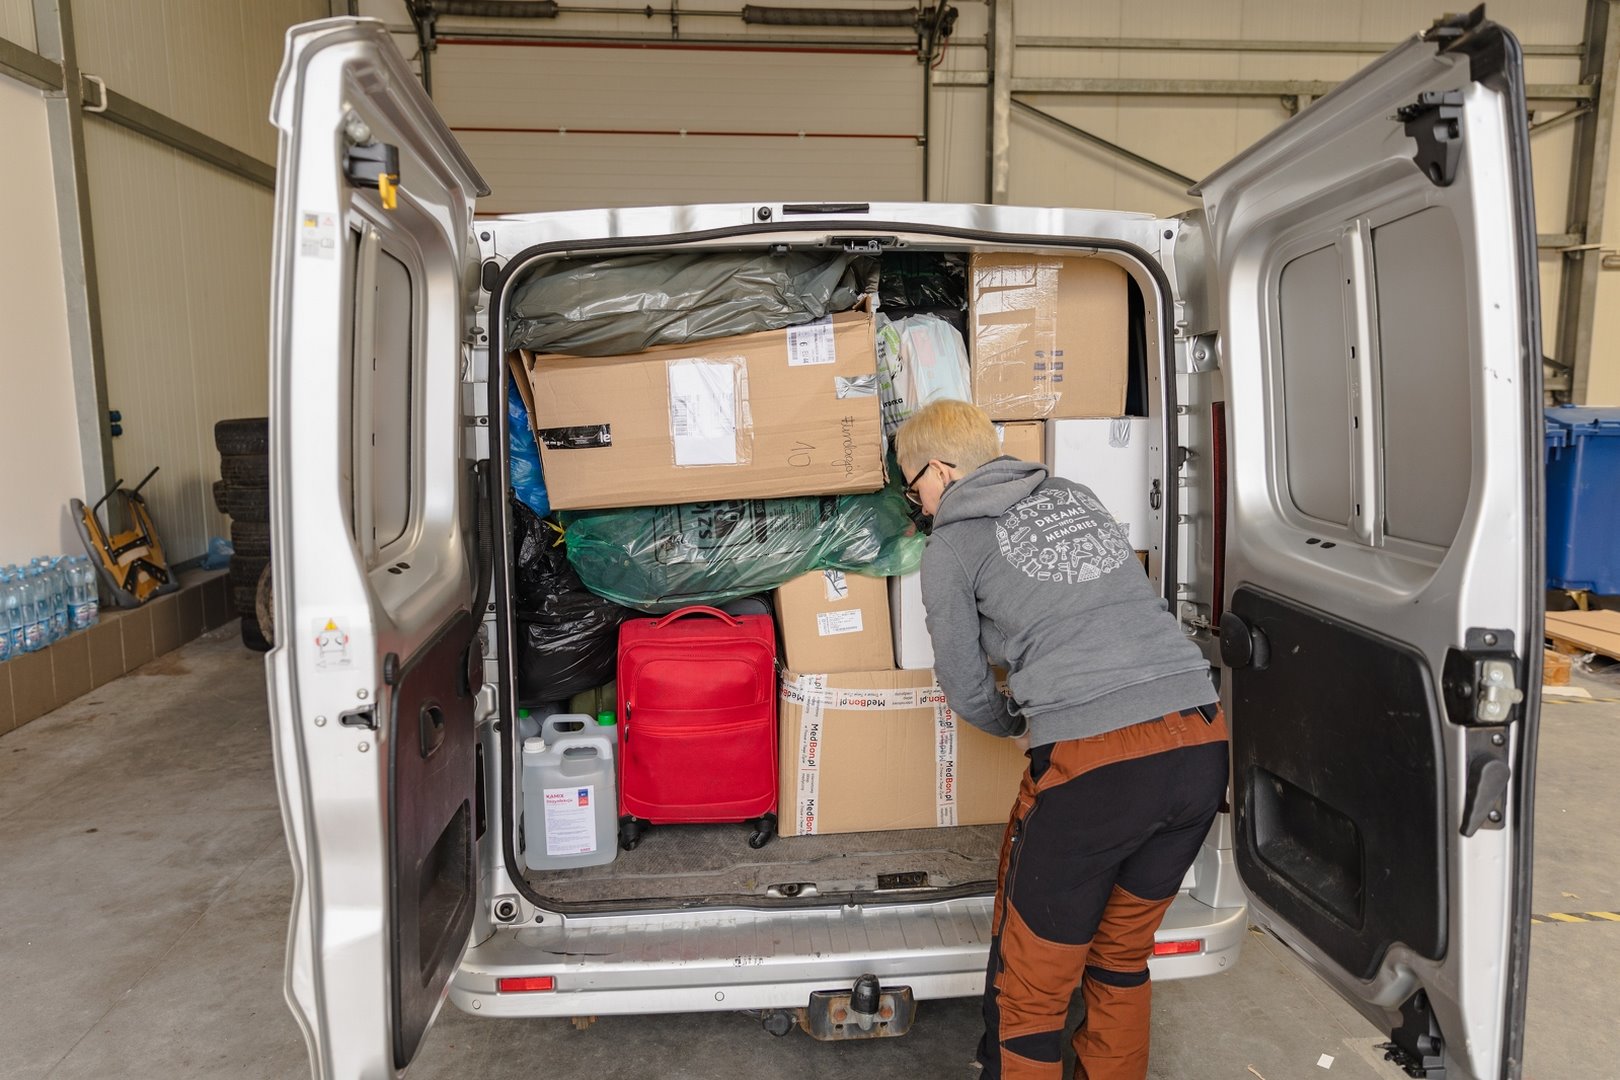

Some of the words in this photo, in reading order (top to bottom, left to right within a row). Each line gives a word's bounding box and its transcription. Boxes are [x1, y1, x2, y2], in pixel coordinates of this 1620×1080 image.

[787, 441, 816, 468] 10
[1034, 506, 1087, 528] DREAMS
[1058, 518, 1075, 527] INTO
[1045, 519, 1098, 543] MEMORIES
[839, 698, 886, 708] MedBon.pl
[920, 696, 946, 705] Bon.pl
[808, 723, 819, 767] MedBon.pl
[945, 760, 954, 802] MedBon.pl
